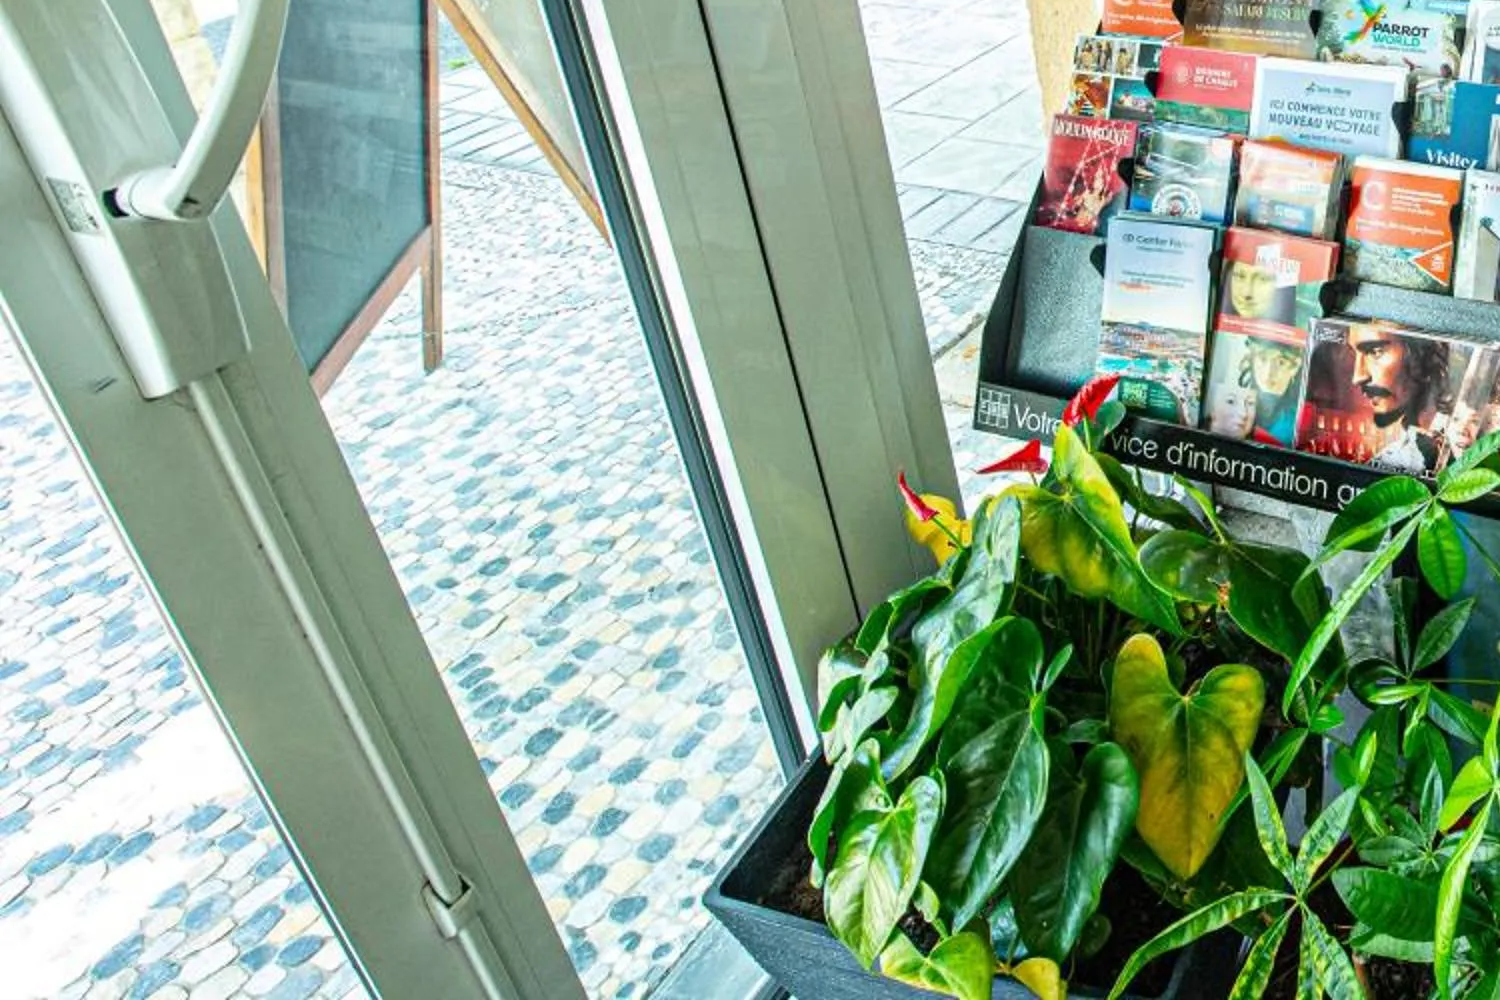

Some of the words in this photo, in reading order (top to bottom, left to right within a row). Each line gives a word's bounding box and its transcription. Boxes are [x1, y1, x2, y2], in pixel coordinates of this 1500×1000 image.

[1373, 21, 1430, 38] PARROT
[1372, 34, 1421, 48] WORLD
[1268, 112, 1323, 127] NOUVEAU
[1287, 101, 1346, 117] COMMENCE
[1350, 109, 1382, 122] VOTRE
[1111, 430, 1160, 459] vice
[1166, 436, 1328, 501] d'information
